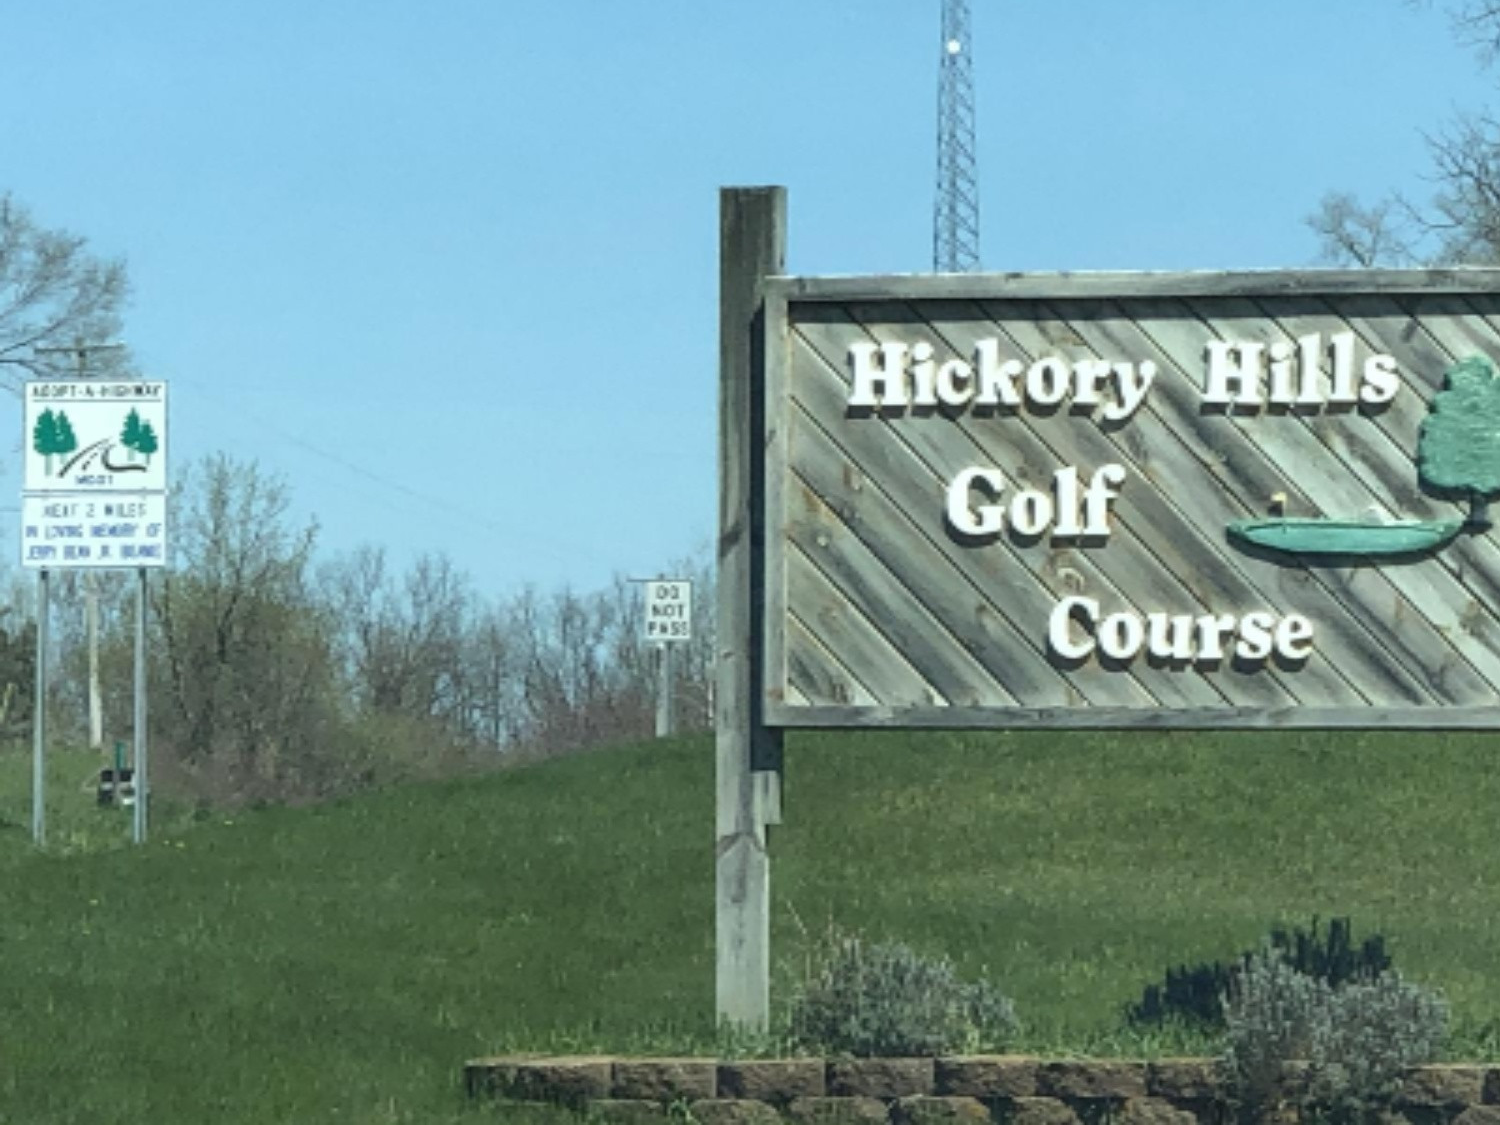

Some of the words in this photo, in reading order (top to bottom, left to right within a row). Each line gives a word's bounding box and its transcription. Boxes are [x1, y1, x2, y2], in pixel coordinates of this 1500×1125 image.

[846, 338, 1156, 422] Hickory
[1203, 332, 1401, 408] Hills
[945, 464, 1126, 539] Golf
[85, 503, 95, 518] 2
[655, 584, 680, 600] DO
[652, 604, 684, 618] NOT
[648, 621, 688, 636] PASS
[1047, 595, 1314, 661] Course
